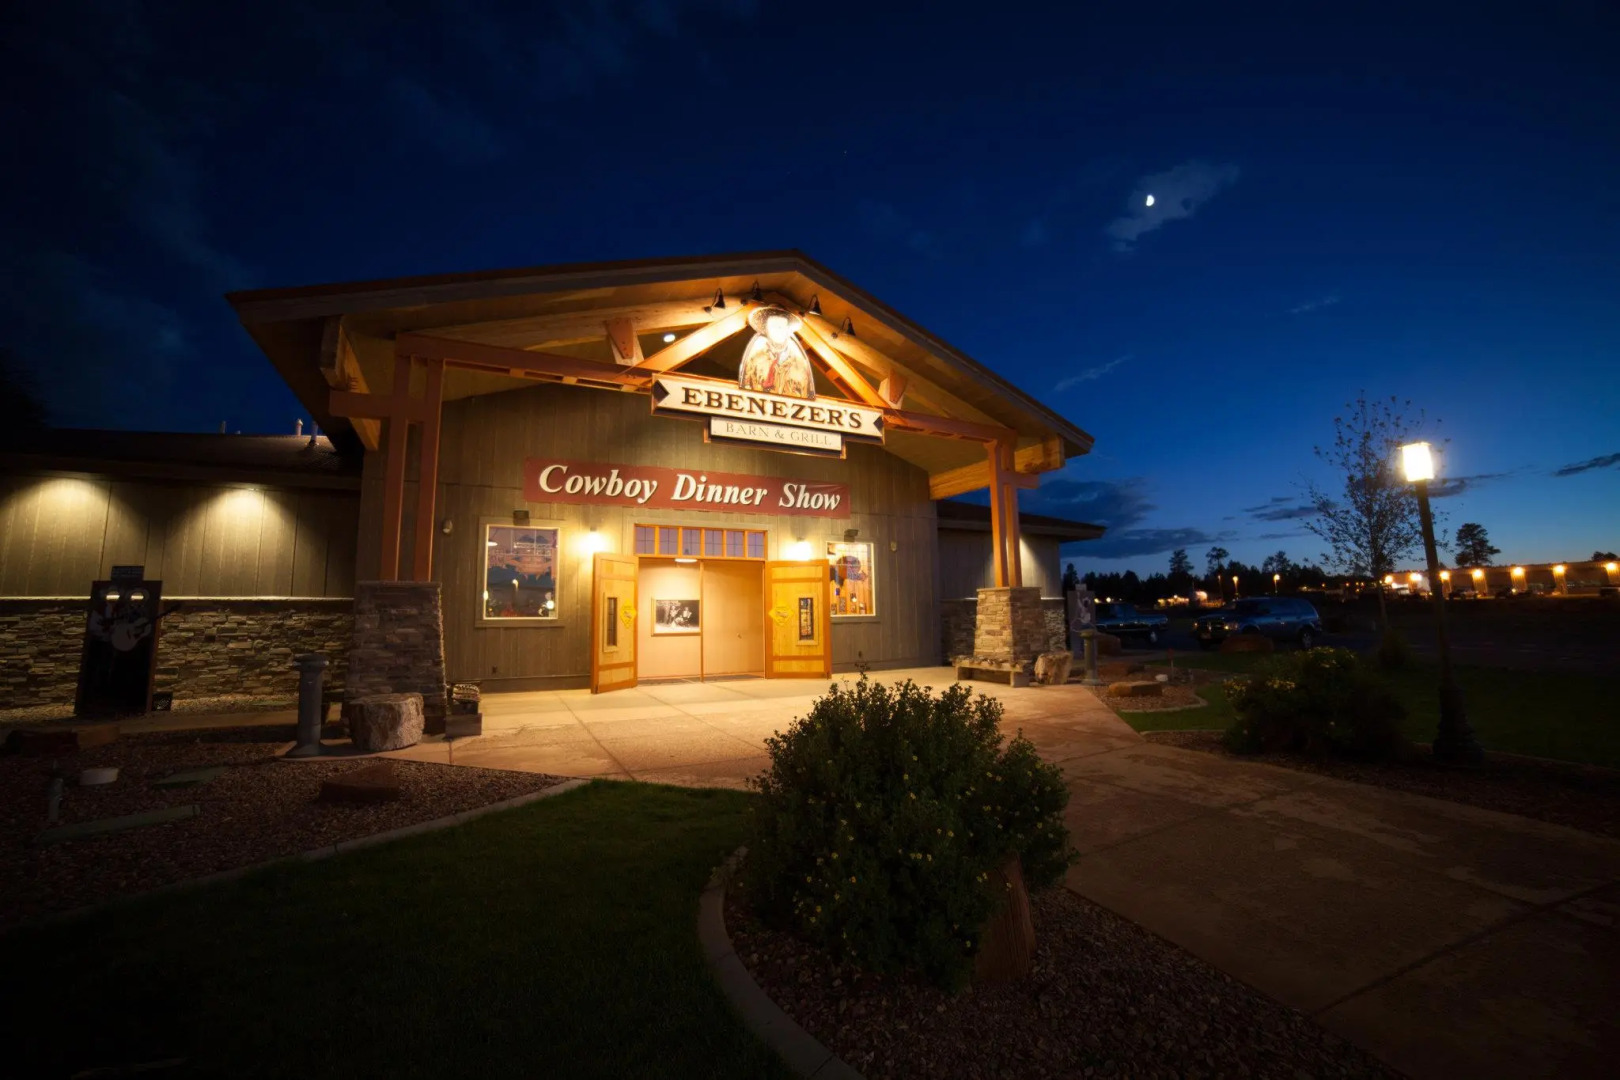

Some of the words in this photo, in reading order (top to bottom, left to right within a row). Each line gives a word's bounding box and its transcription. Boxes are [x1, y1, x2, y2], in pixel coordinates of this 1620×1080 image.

[682, 386, 862, 428] EBENEZER'S
[726, 422, 769, 438] BARN
[774, 429, 785, 440] &
[790, 431, 832, 446] GRILL
[539, 464, 658, 504] Cowboy
[671, 473, 768, 506] Dinner
[779, 483, 841, 511] Show
